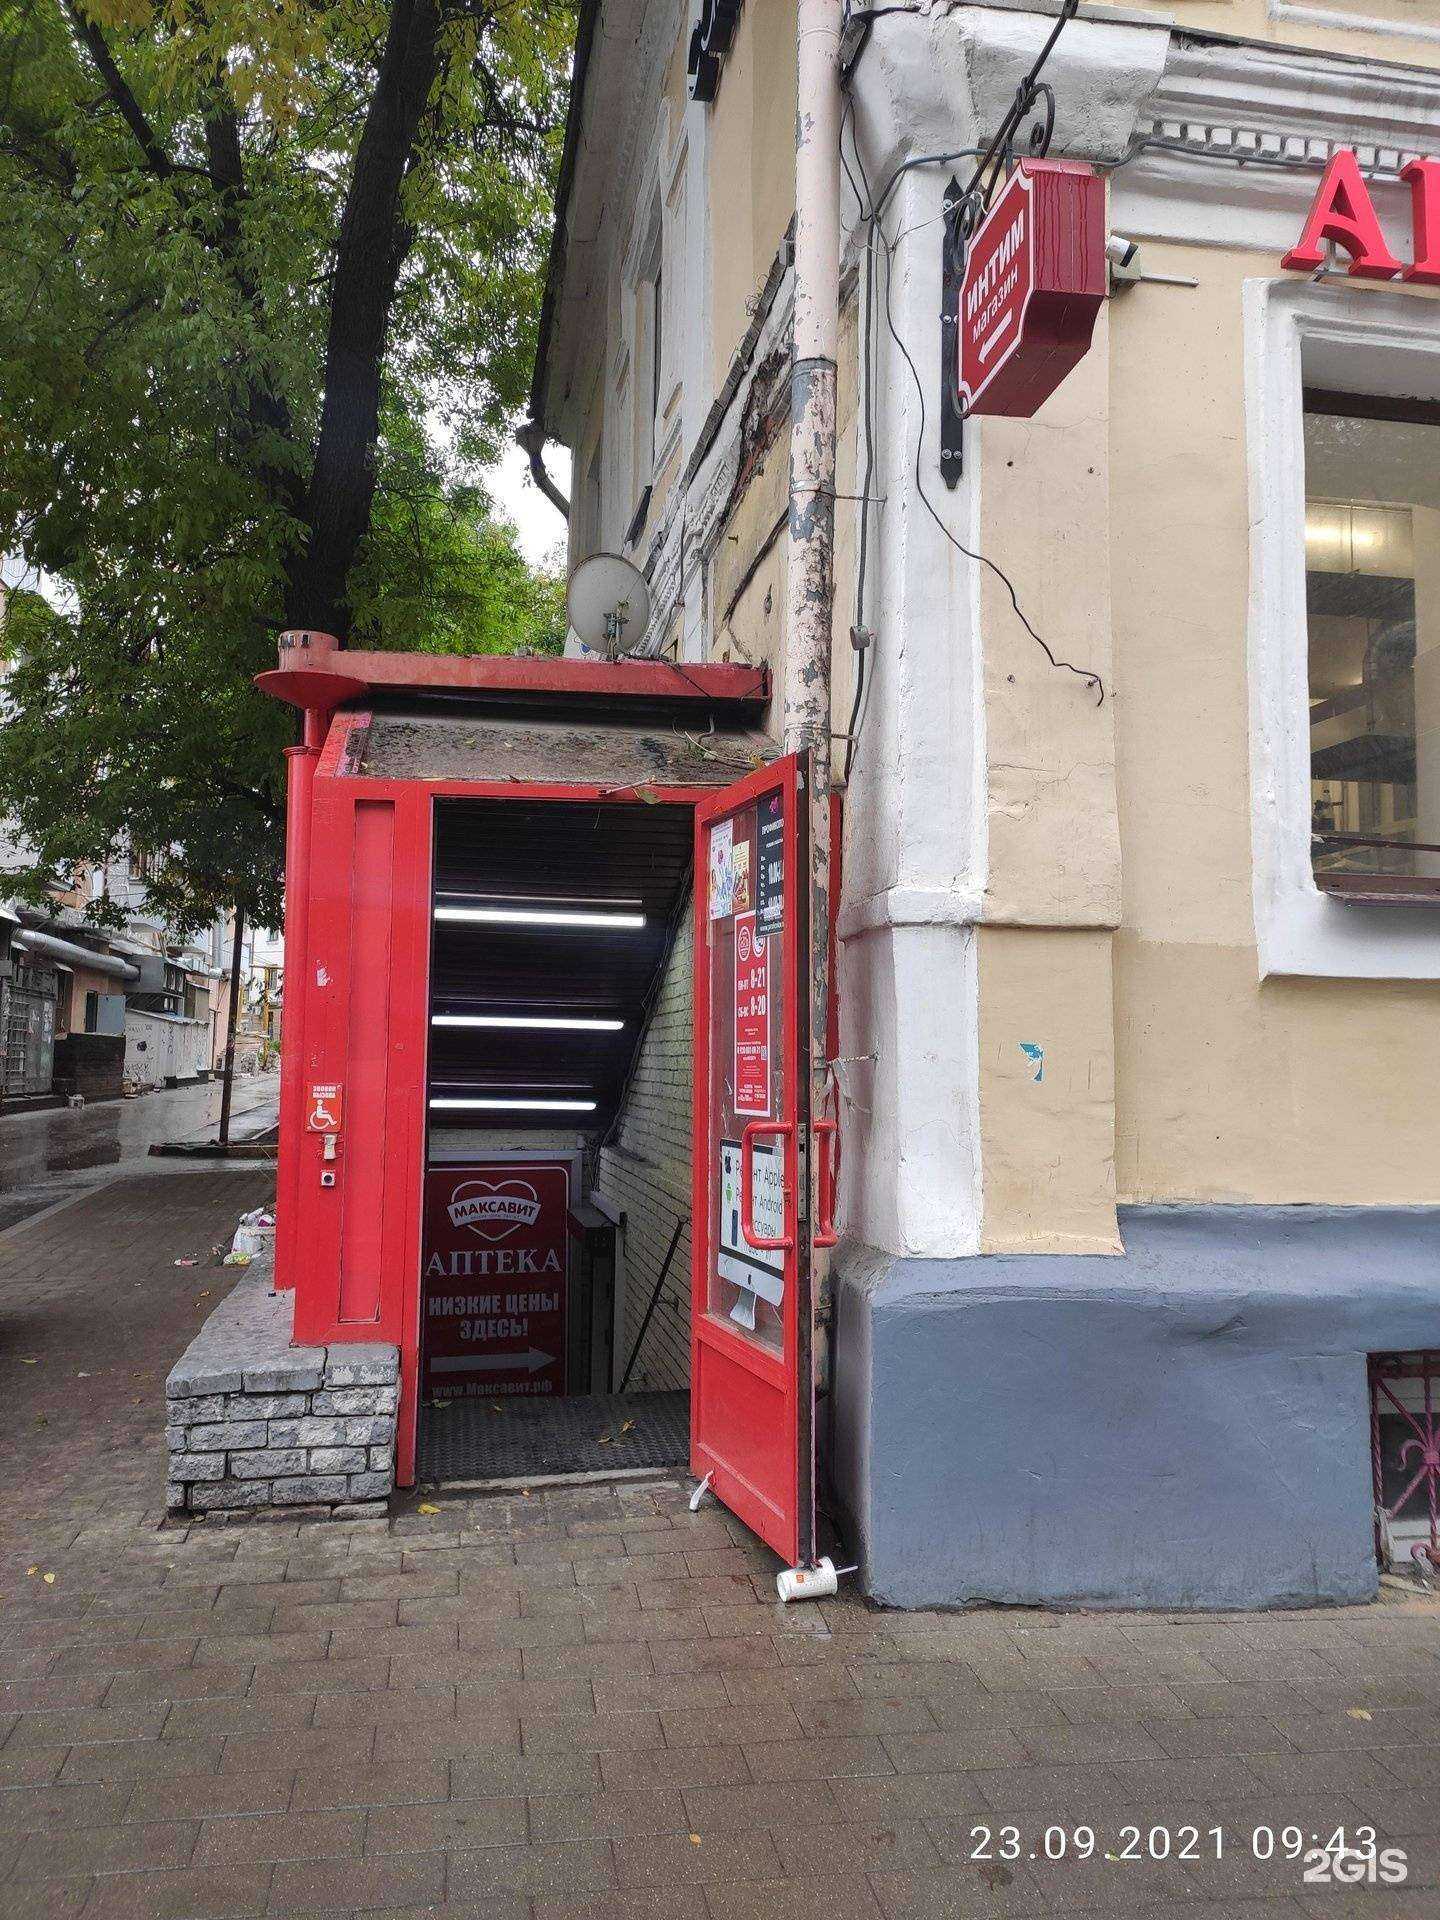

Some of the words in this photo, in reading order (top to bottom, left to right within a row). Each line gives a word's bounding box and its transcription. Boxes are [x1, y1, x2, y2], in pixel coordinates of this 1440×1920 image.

[967, 209, 1024, 321] ИНТИМ
[973, 265, 1018, 343] магазин
[750, 967, 765, 988] 8-21
[750, 995, 766, 1017] 8-20
[454, 1201, 536, 1218] МАКСАВИТ
[426, 1248, 562, 1276] АПТЕКА
[429, 1295, 501, 1316] НИЗКИЕ
[506, 1293, 559, 1315] ЦЕНЫ
[460, 1318, 528, 1342] ЗДЕСЬ!
